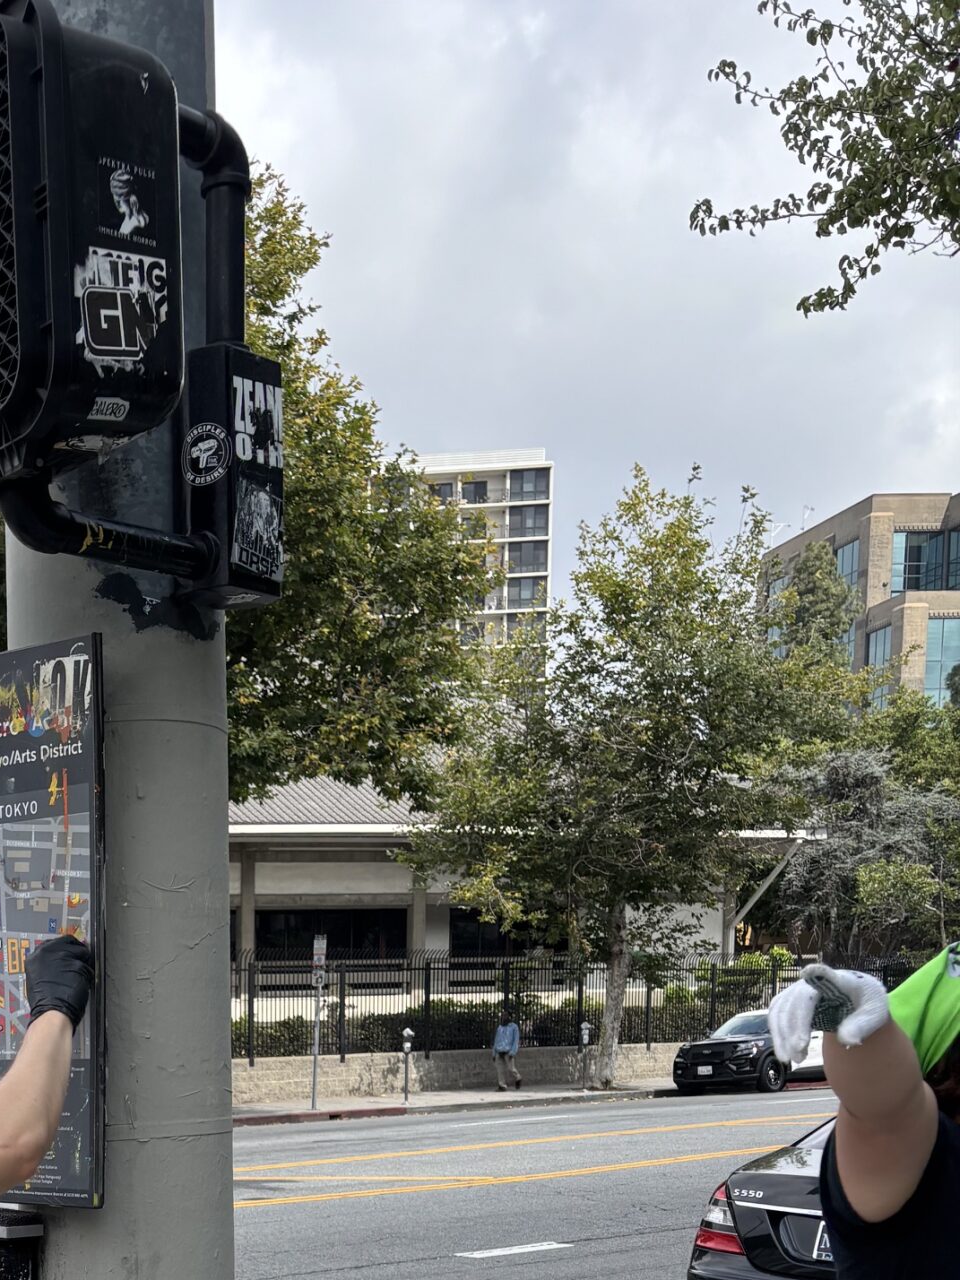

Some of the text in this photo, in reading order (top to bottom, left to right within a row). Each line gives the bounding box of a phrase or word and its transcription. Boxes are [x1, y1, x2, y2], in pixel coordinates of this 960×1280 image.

[133, 165, 156, 179] PULSE
[132, 234, 157, 248] HORROR
[186, 424, 226, 442] DISCIPLES
[186, 466, 226, 484] OF DESIRE
[40, 739, 83, 762] District
[733, 1188, 764, 1199] S550
